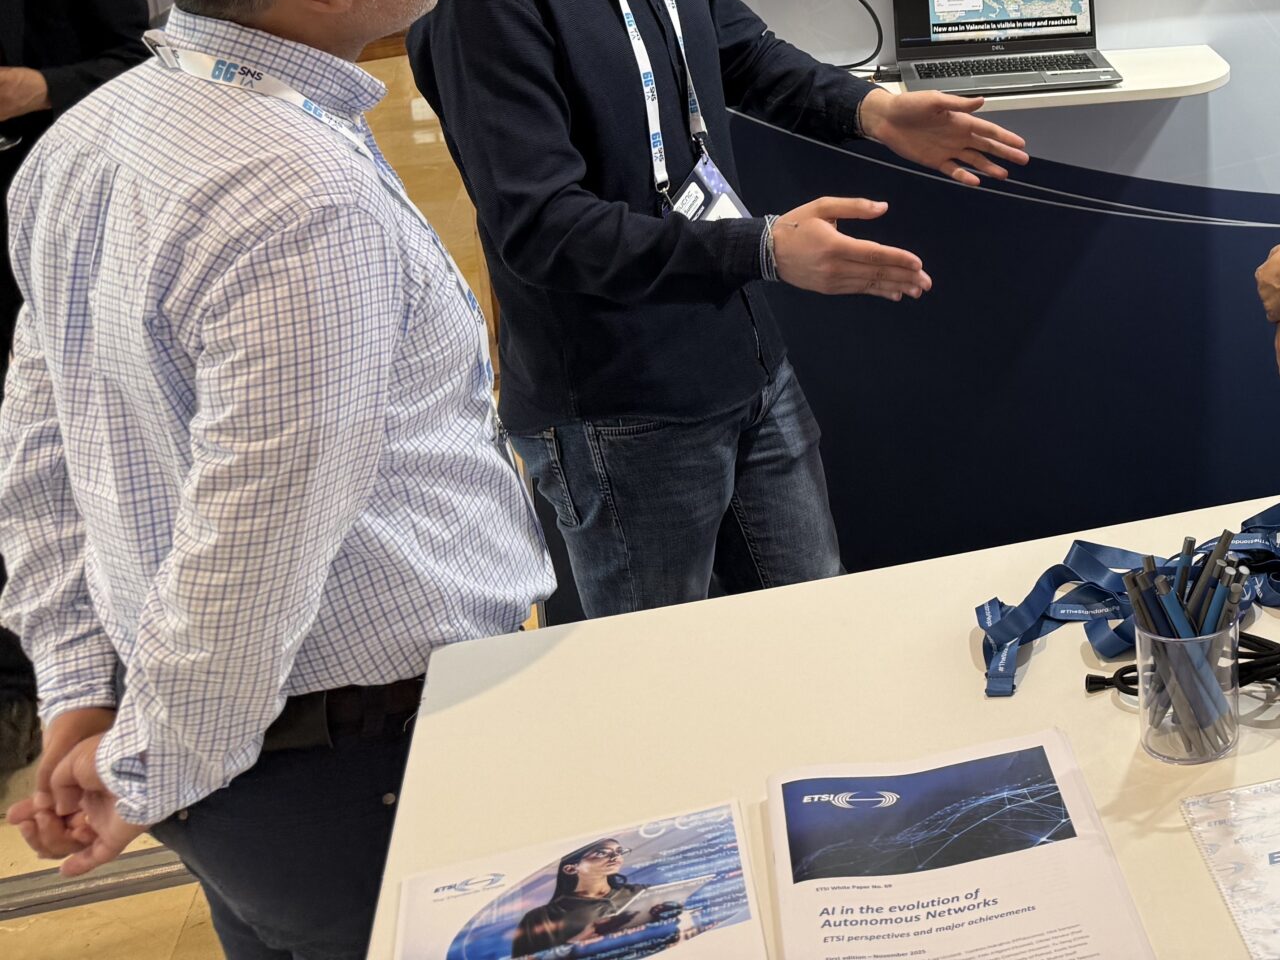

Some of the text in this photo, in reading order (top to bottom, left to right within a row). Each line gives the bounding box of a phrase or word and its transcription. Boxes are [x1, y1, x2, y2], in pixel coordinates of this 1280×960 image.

[625, 12, 636, 27] 6G
[933, 25, 947, 33] New
[966, 23, 990, 32] Valencia
[997, 21, 1016, 29] visible
[1023, 21, 1036, 29] map
[1048, 17, 1076, 25] reachable
[211, 59, 264, 83] 6G SNS
[642, 71, 654, 88] 6G
[652, 132, 662, 149] 6G
[802, 793, 834, 804] ETSI
[819, 888, 981, 917] AI in the evolution of
[821, 898, 999, 929] Autonomous Networks
[823, 905, 1036, 943] ETSI perspectives and major achievements
